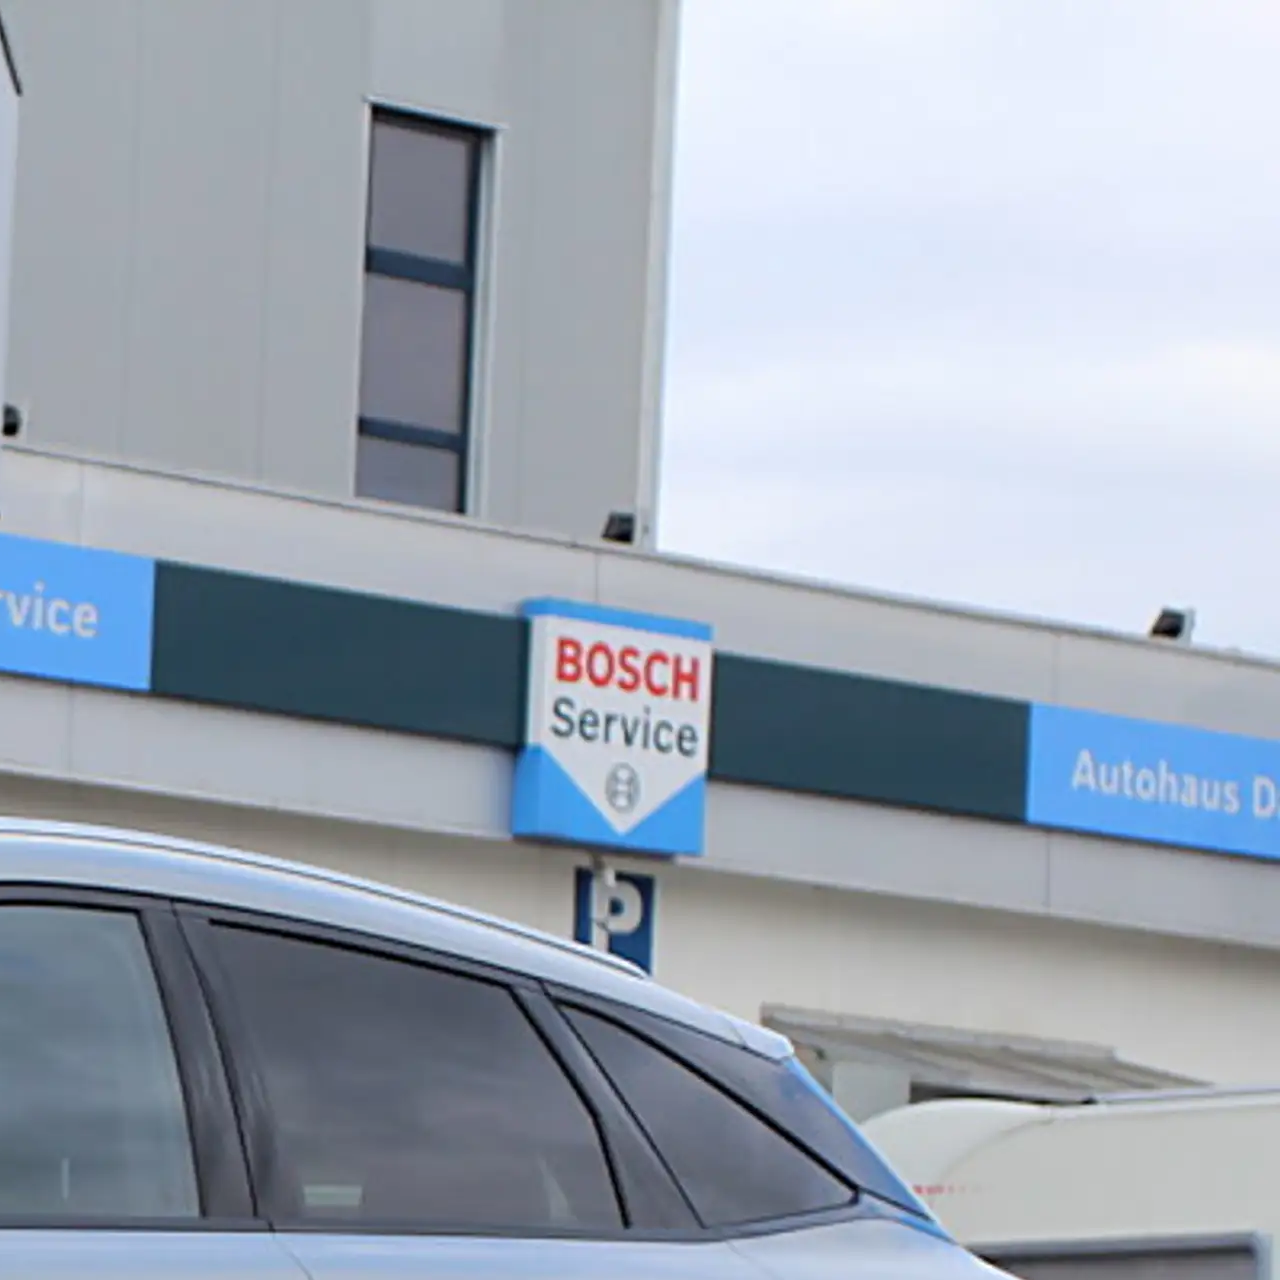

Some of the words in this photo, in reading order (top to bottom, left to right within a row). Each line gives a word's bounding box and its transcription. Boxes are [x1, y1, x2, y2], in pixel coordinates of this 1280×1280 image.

[555, 637, 701, 702] BOSCH
[550, 697, 699, 758] Service
[1071, 749, 1241, 814] Autohaus
[592, 877, 643, 950] P
